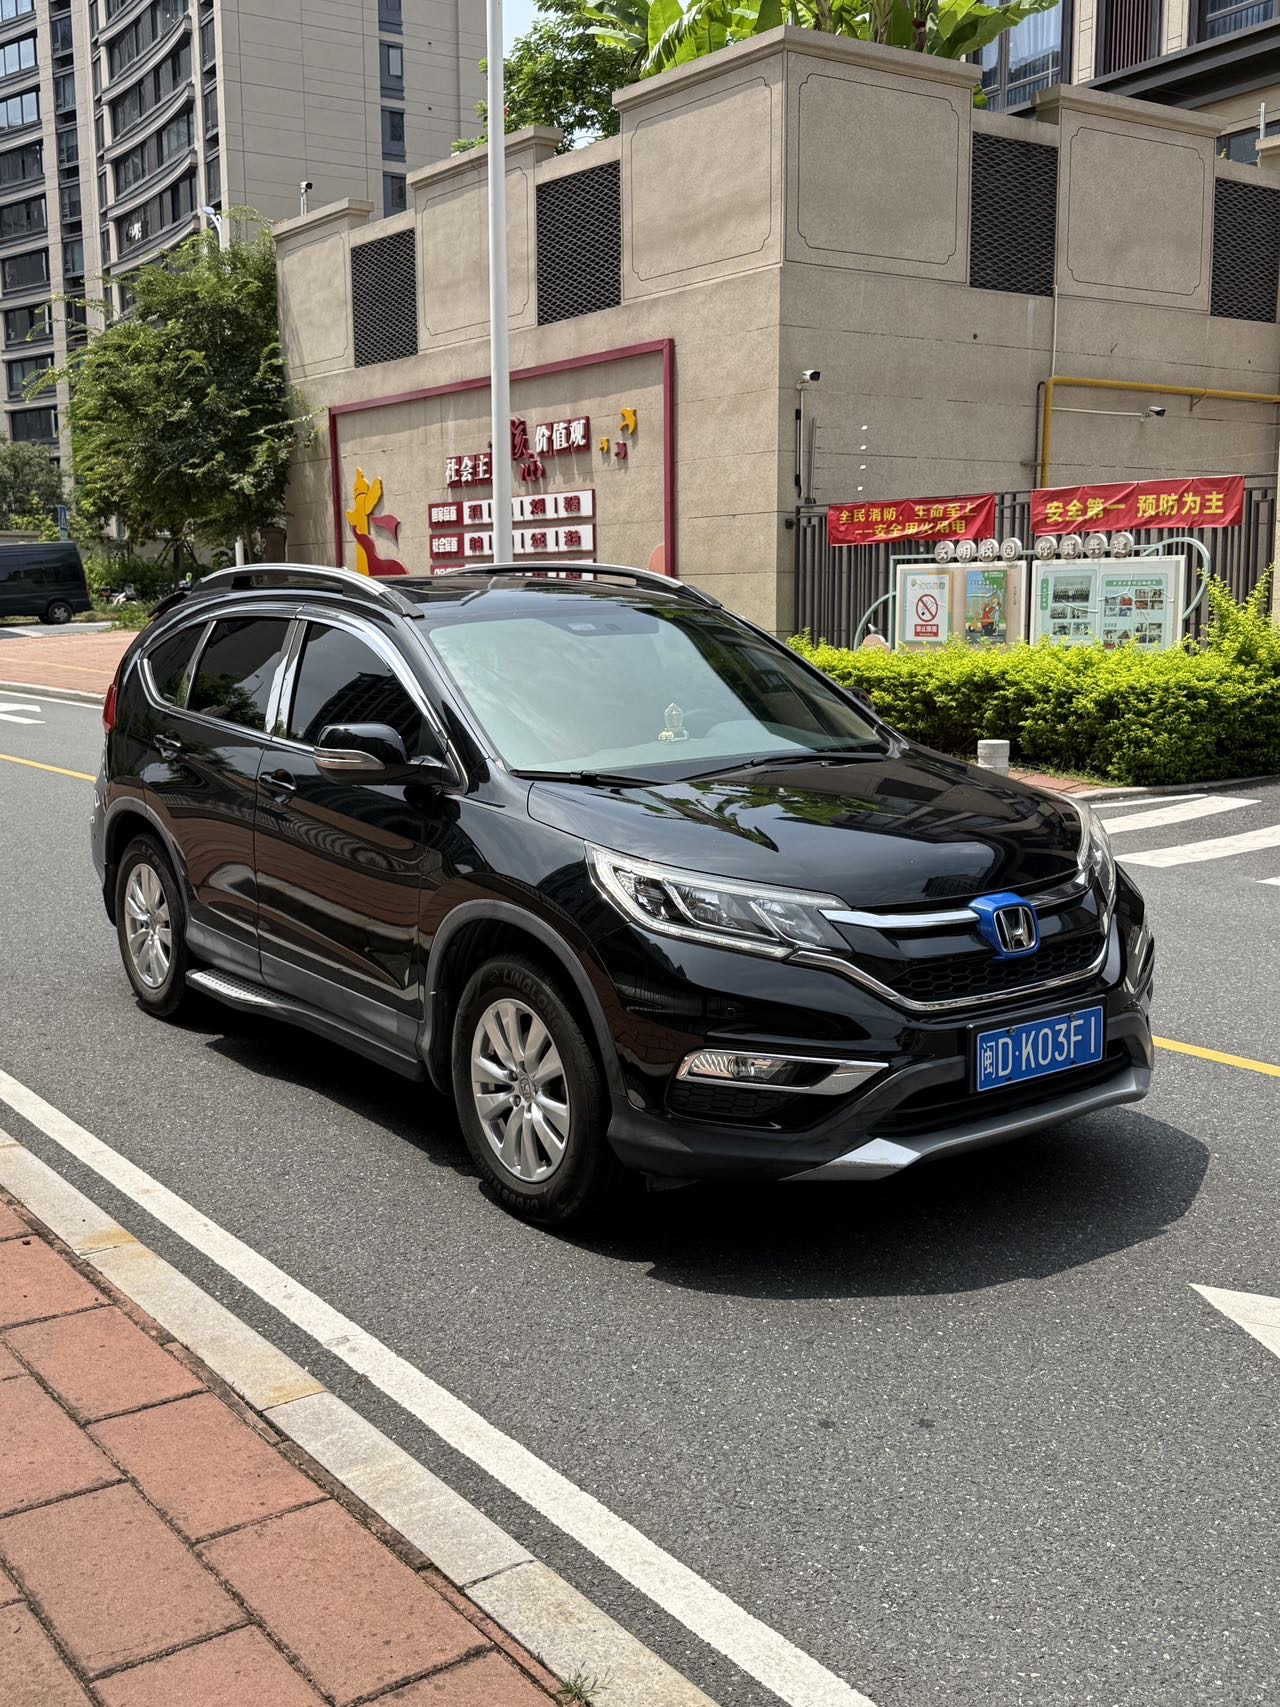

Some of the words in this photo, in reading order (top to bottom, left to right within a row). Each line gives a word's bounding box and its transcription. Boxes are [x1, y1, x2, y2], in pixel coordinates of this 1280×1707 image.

[446, 455, 493, 484] 社会主
[535, 419, 587, 454] 价值观
[1045, 497, 1126, 523] 安全第一
[1136, 491, 1225, 518] 预防为主
[937, 541, 1015, 559] 文明校园
[1038, 536, 1128, 556] 你我共建
